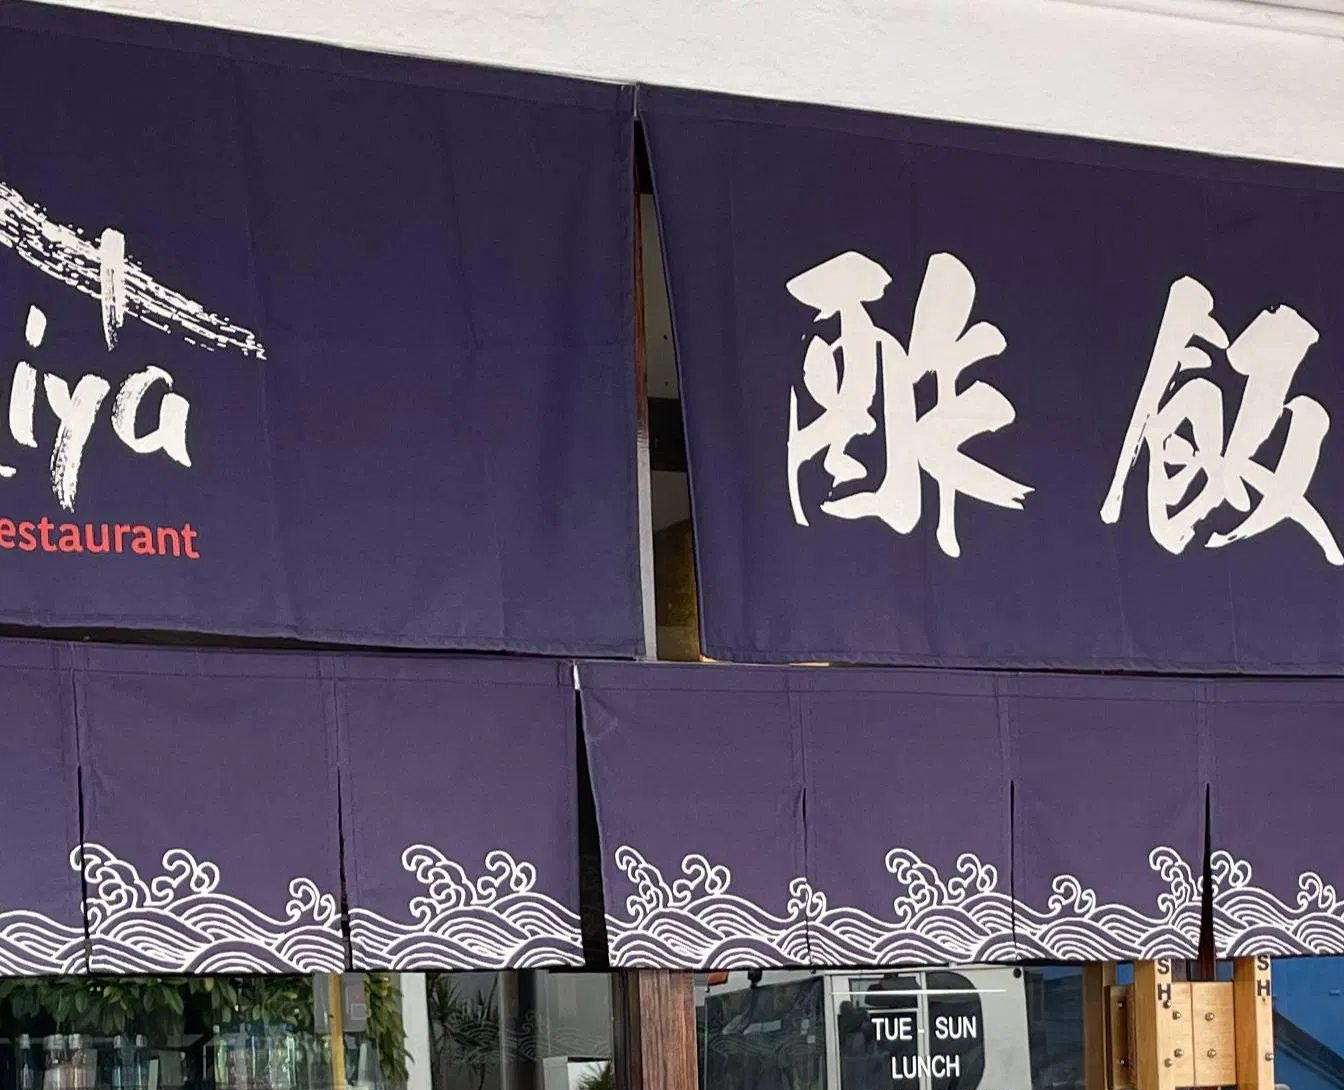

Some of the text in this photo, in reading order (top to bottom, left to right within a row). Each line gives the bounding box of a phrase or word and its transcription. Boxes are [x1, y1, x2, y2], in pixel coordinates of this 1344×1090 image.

[871, 1017, 913, 1040] TUE
[934, 1016, 977, 1040] SUN
[891, 1055, 960, 1080] LUNCH
